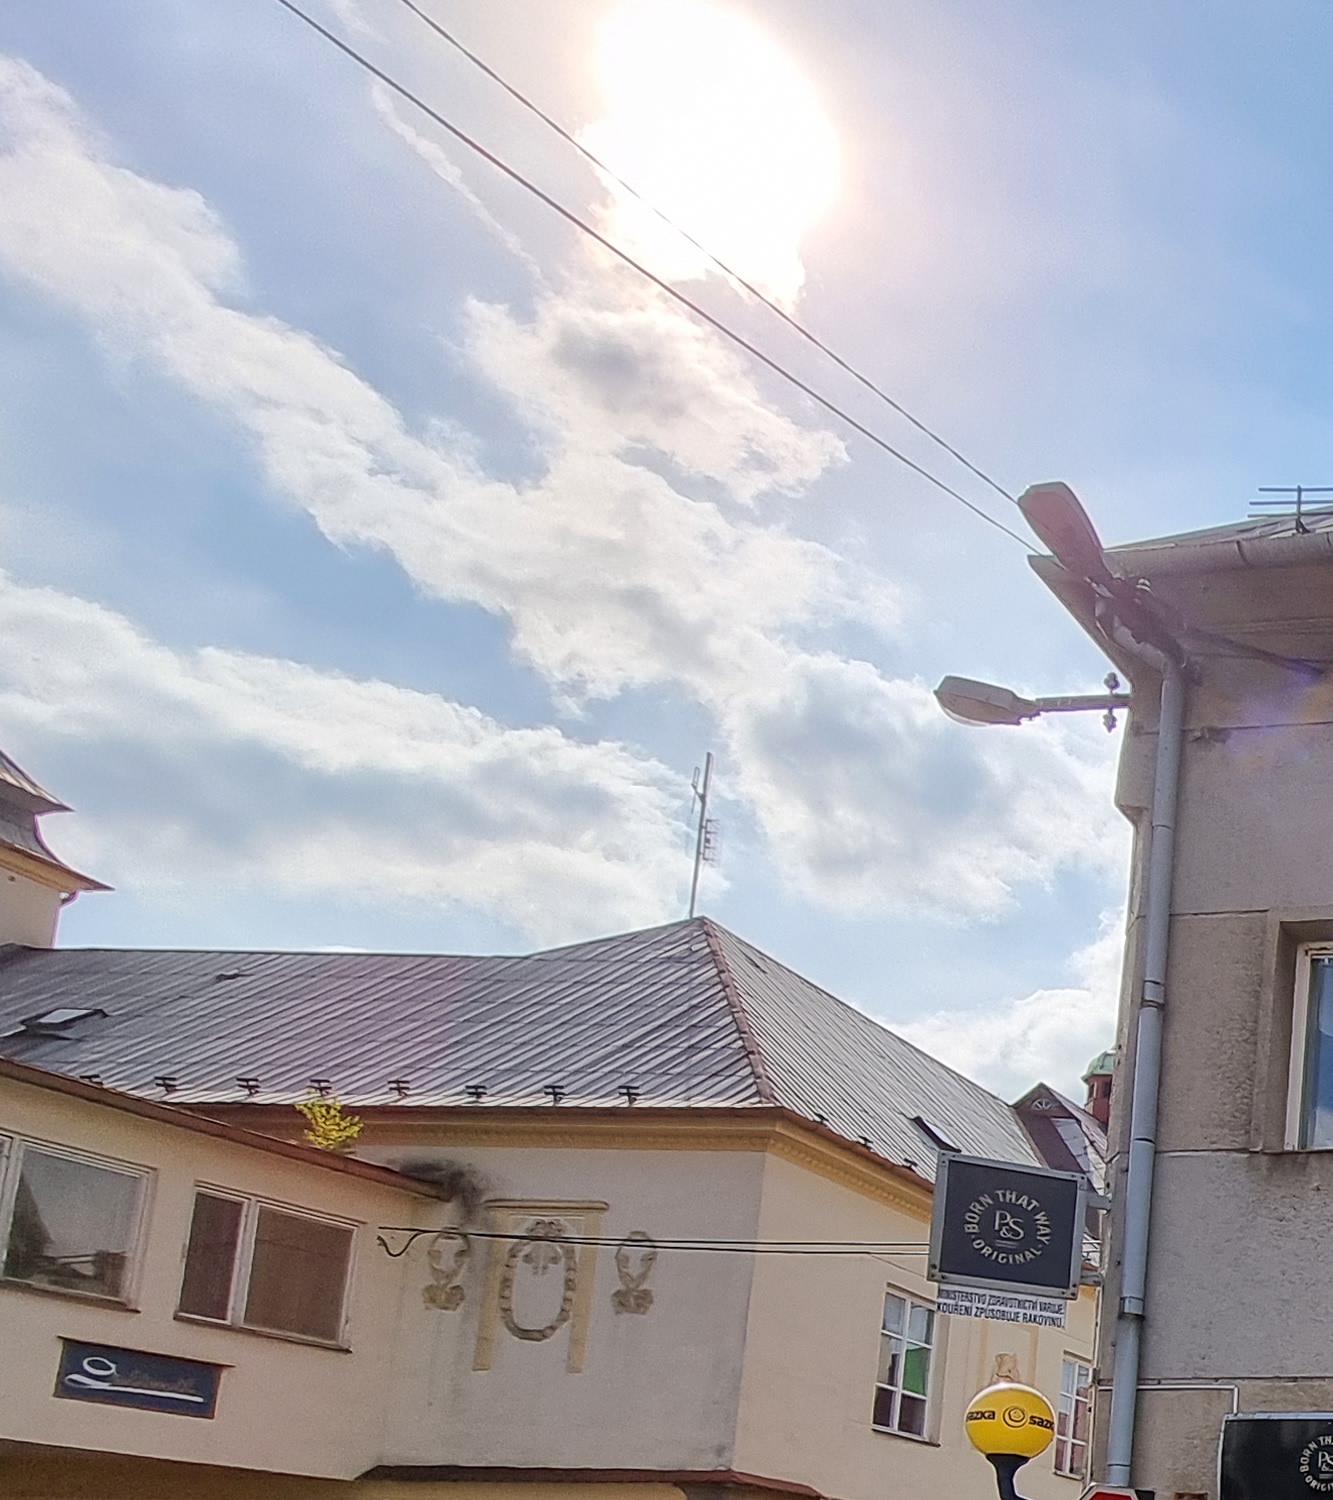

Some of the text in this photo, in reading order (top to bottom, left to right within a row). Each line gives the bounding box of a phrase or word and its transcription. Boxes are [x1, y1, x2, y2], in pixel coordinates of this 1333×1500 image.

[964, 1189, 1052, 1245] BORN THAT WAY
[973, 1239, 1042, 1265] ORIGINAL
[966, 1410, 1055, 1431] azka sazk
[1300, 1441, 1318, 1472] BORN
